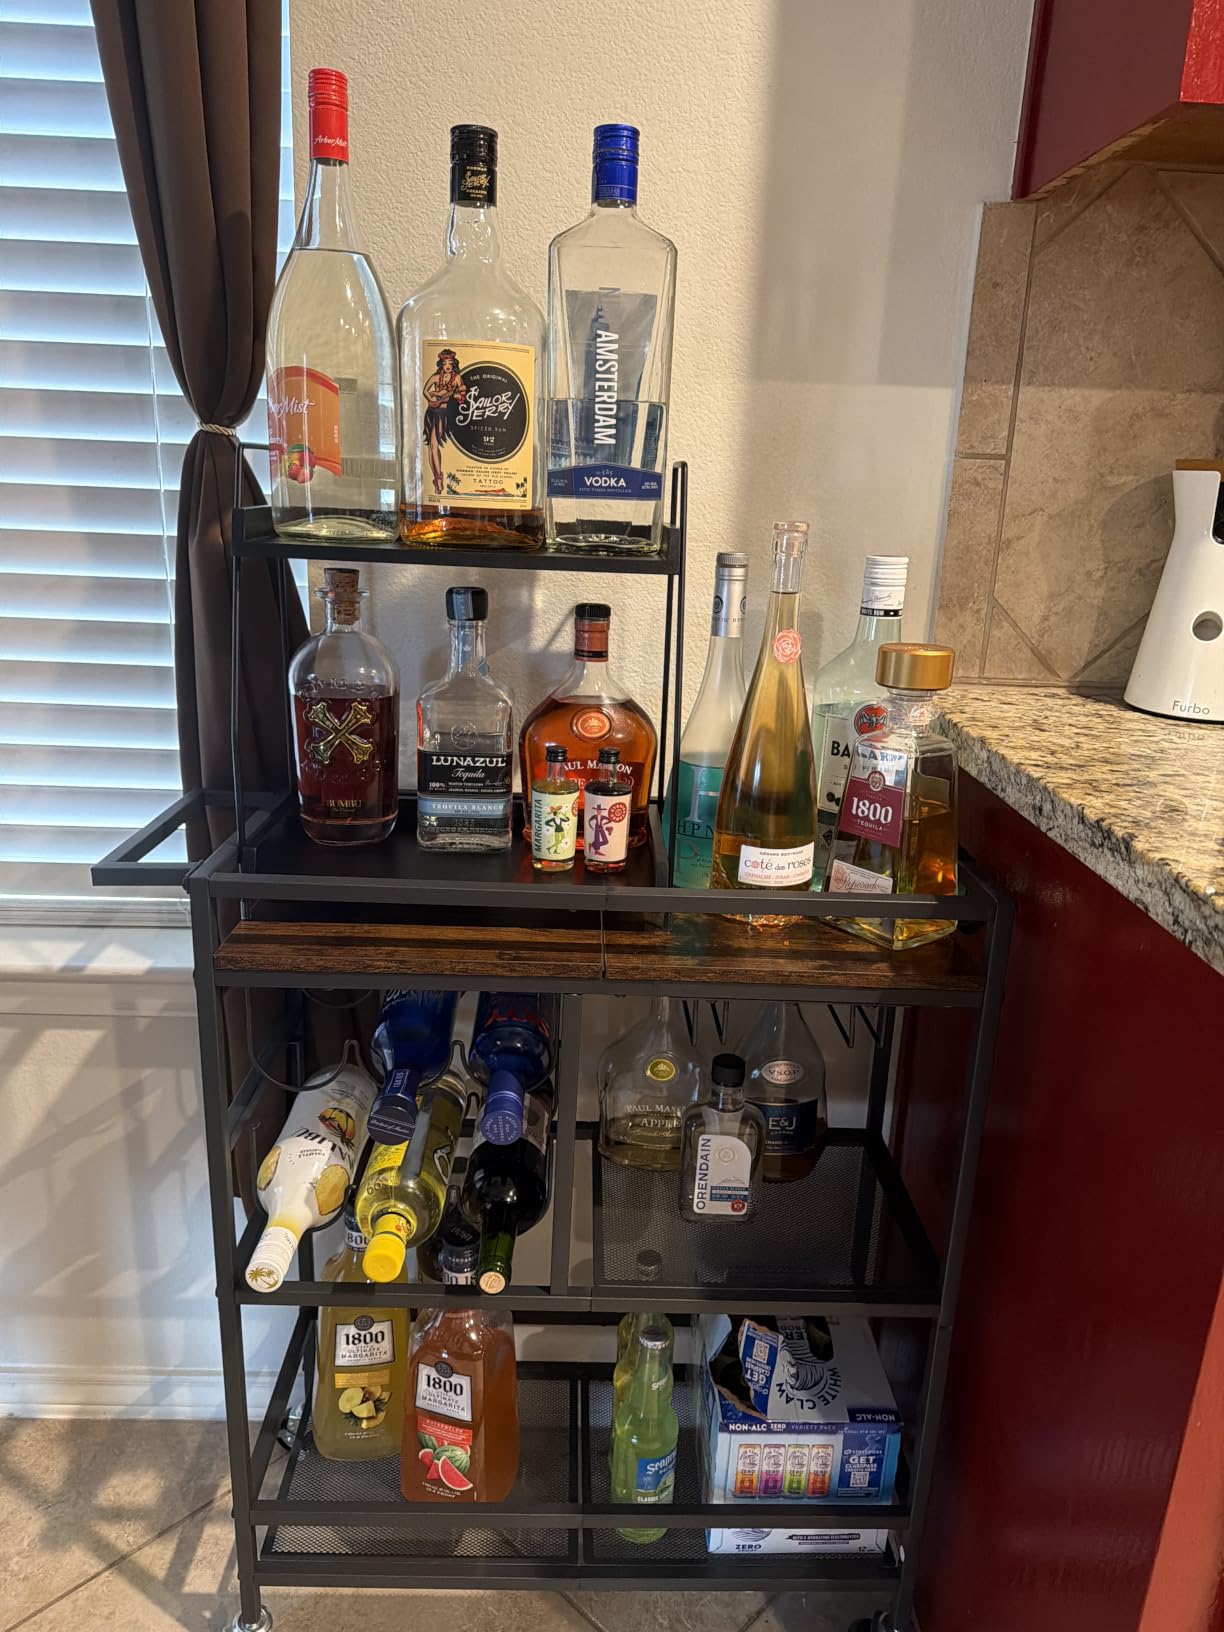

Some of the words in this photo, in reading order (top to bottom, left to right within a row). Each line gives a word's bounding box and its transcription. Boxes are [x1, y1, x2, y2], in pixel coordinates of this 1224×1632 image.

[483, 374, 508, 383] ORIGINAL
[593, 329, 619, 445] AMSTERDAM
[281, 396, 317, 415] Mist
[584, 476, 627, 488] VODKA
[1172, 700, 1210, 715] Furbo
[432, 756, 506, 767] LUNAZUL
[563, 761, 584, 772] AUL
[587, 760, 633, 775] MAON
[452, 768, 486, 781] Tequila
[851, 797, 893, 824] 1800
[534, 800, 543, 853] MARGARITA
[857, 819, 883, 831] TEQUILA
[788, 856, 812, 870] roses
[838, 875, 880, 894] Reposado
[626, 1104, 651, 1112] PAUL
[655, 1104, 687, 1113] MASS
[640, 1117, 681, 1130] APPLE
[769, 1116, 797, 1130] E&J
[696, 1138, 712, 1210] ORENDAIN
[344, 1331, 385, 1346] 1800
[341, 1351, 387, 1359] MARGARITA
[746, 1371, 766, 1384] GET
[426, 1374, 463, 1396] 1800
[817, 1367, 842, 1406] WHITE
[429, 1391, 460, 1404] ULTIMATE
[776, 1382, 816, 1410] CLAW
[422, 1395, 465, 1412] MARGARITA
[849, 1456, 876, 1464] GET
